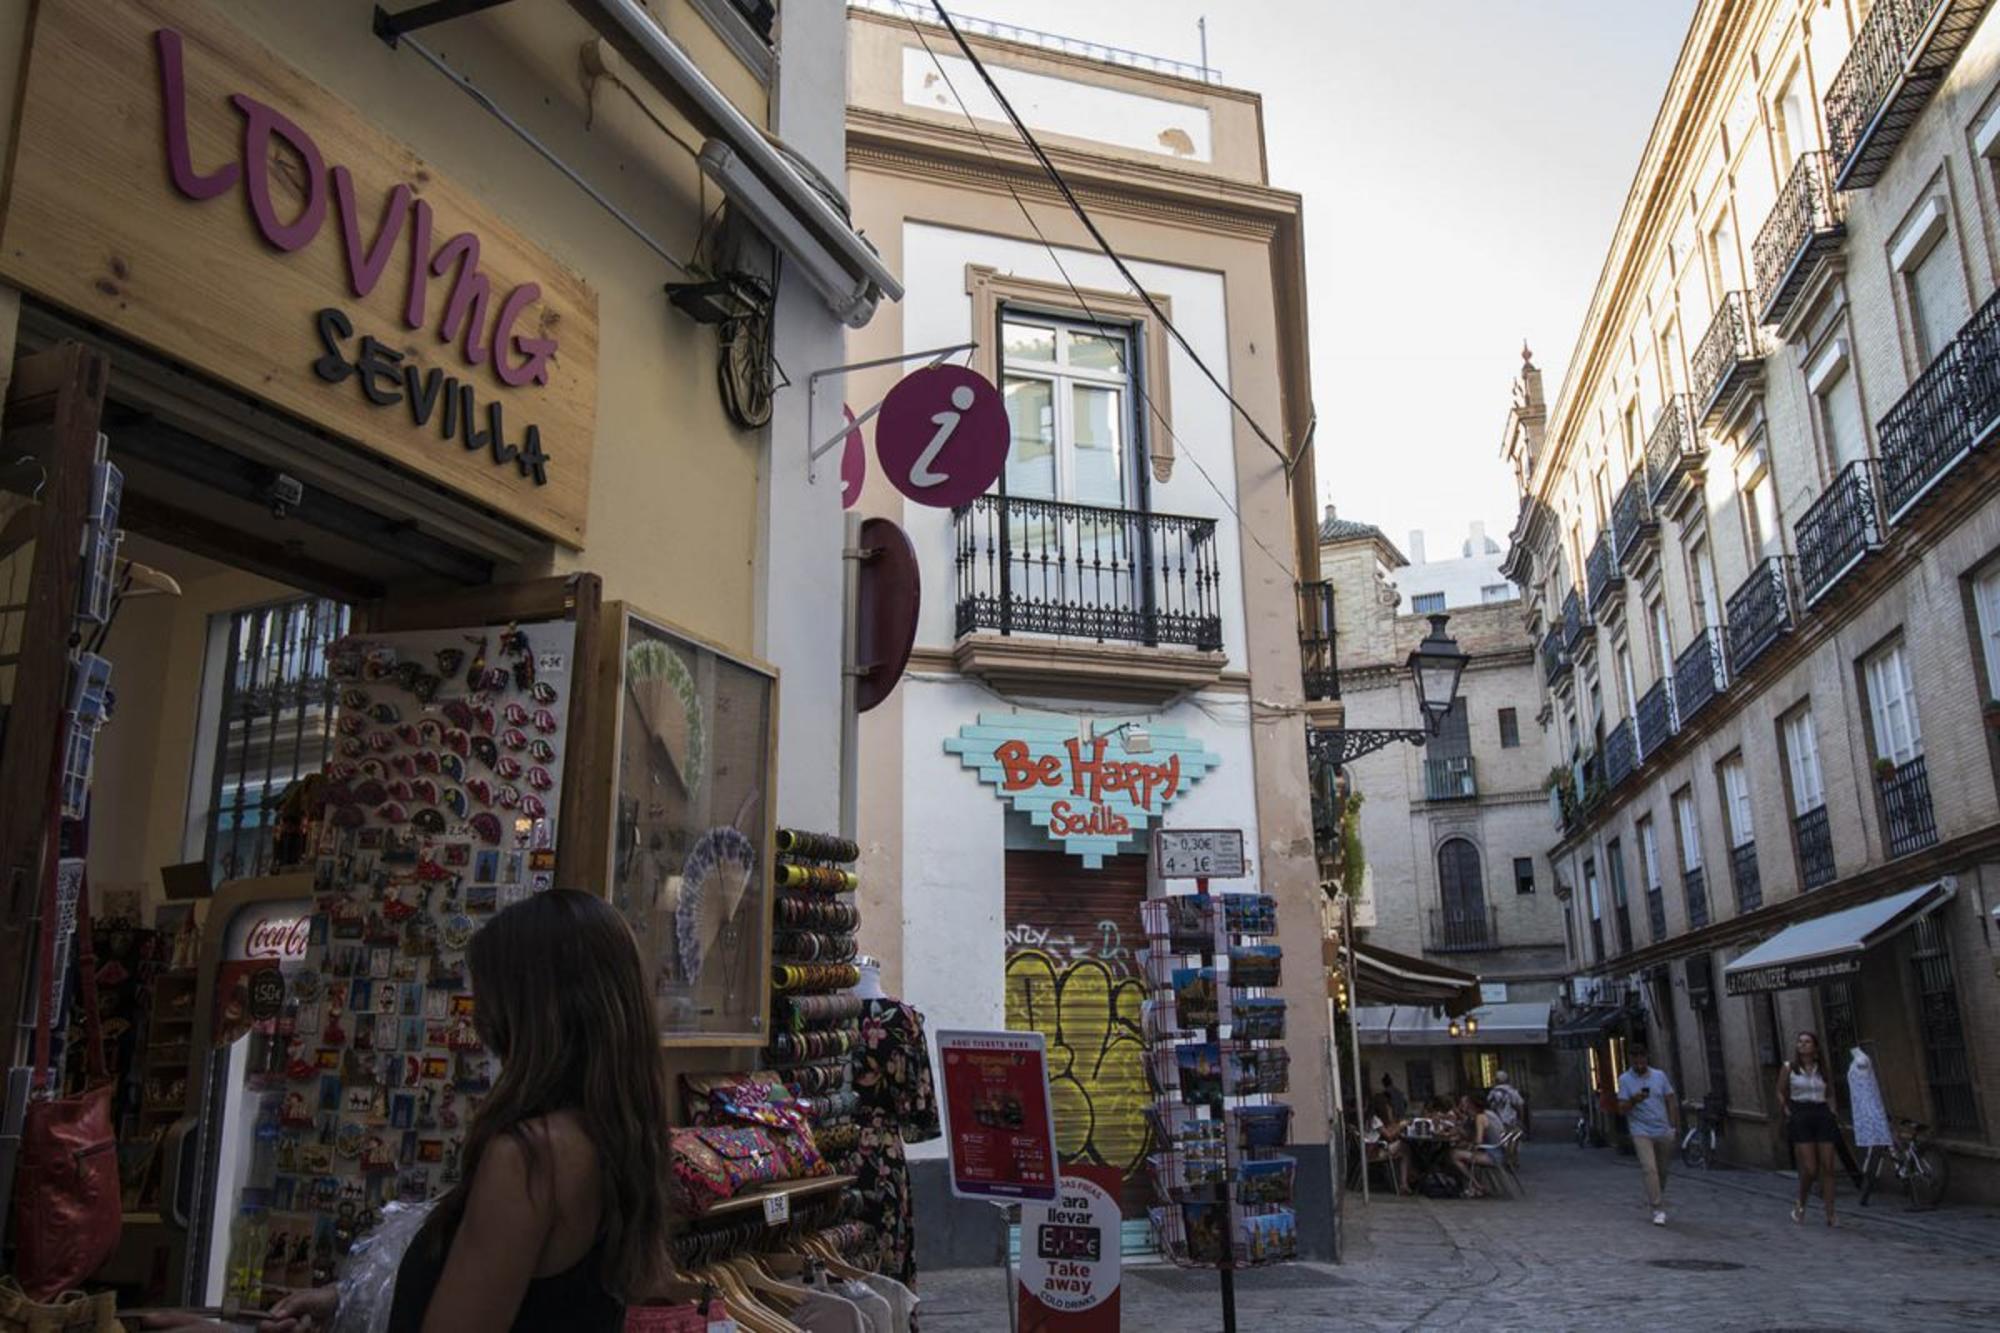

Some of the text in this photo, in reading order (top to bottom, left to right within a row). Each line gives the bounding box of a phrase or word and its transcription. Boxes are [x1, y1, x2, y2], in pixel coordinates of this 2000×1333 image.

[313, 308, 549, 486] SEVILLA
[993, 737, 1180, 812] Be Happy
[1050, 800, 1132, 836] Sevilla
[1166, 857, 1175, 872] 4
[1193, 856, 1211, 872] 1€
[1047, 1208, 1093, 1225] llevar
[1047, 1261, 1091, 1278] Take
[1044, 1279, 1092, 1295] away
[1039, 1291, 1097, 1308] COLD DRINKS
